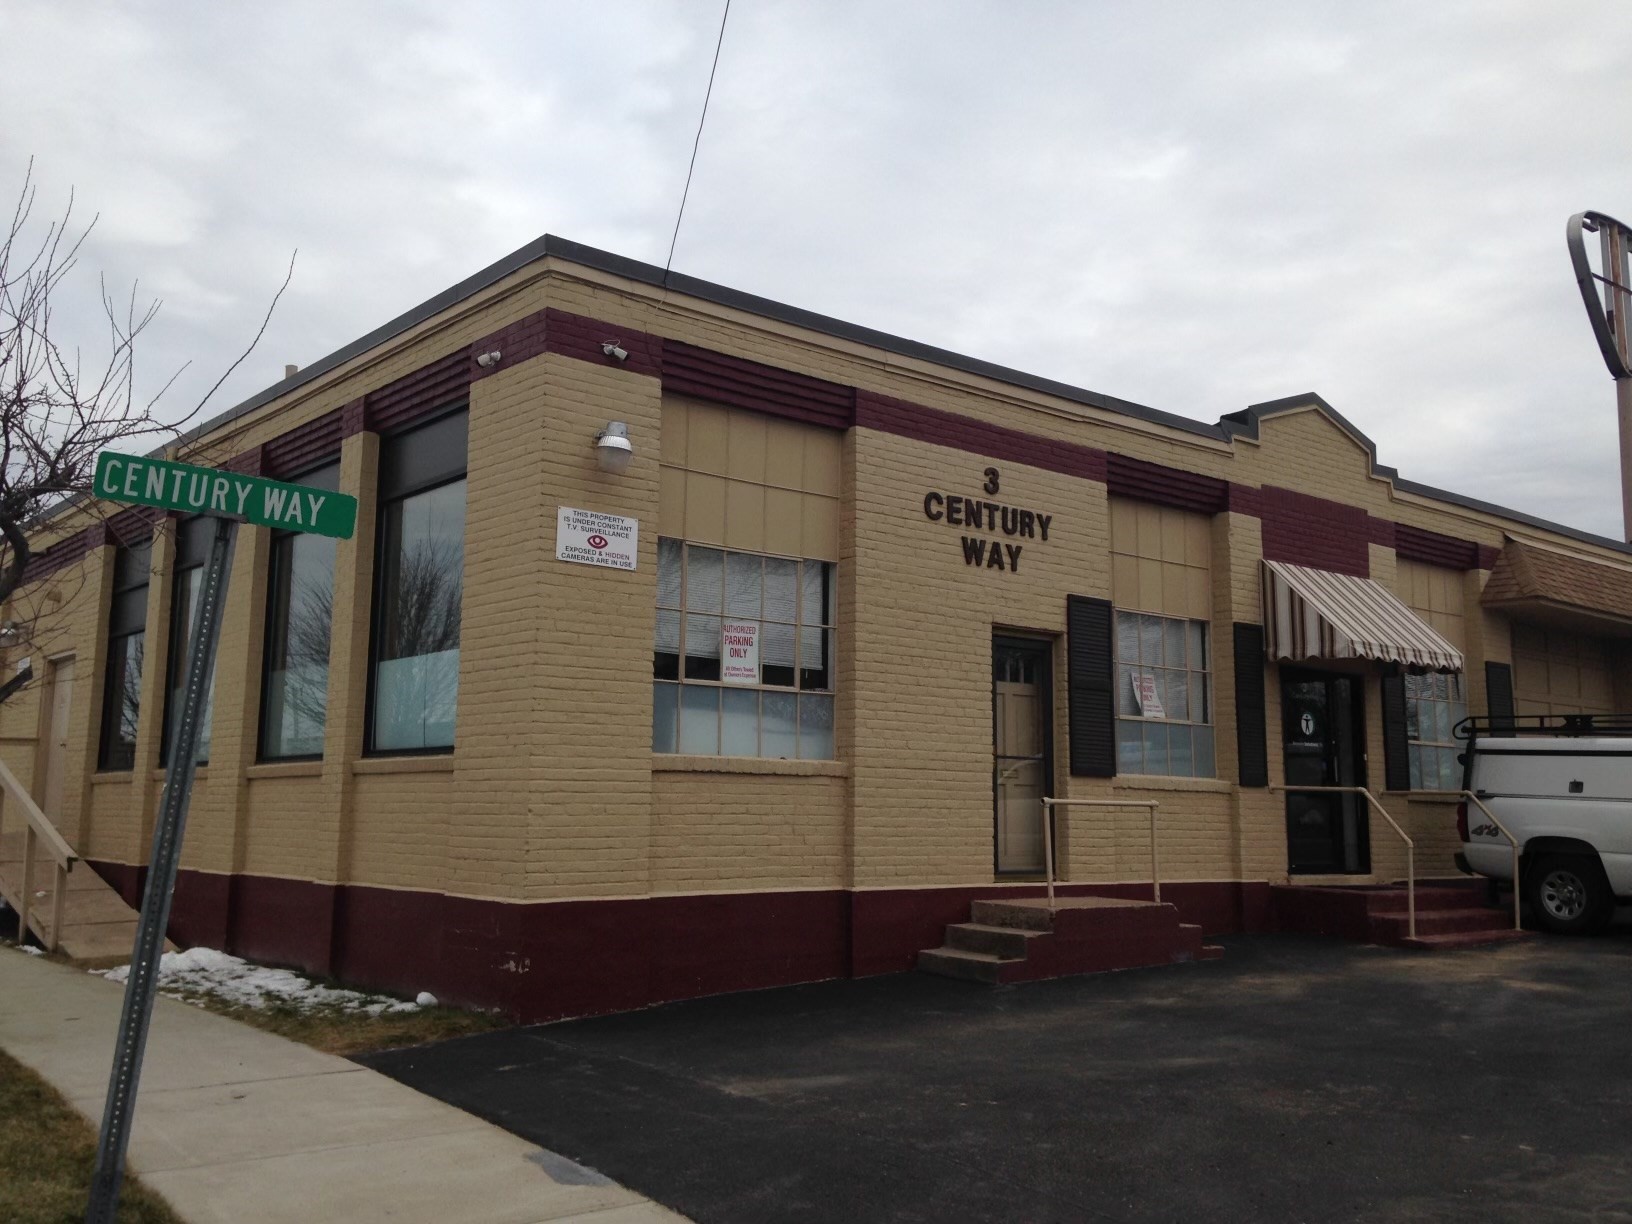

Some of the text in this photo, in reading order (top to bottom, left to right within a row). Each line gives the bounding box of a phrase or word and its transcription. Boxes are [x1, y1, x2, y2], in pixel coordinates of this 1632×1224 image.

[983, 467, 1000, 495] 3
[102, 459, 326, 527] CENTURY WAY
[573, 510, 625, 524] THIS PROPERTY
[924, 491, 1052, 541] CENTURY
[572, 517, 596, 526] UNDER
[597, 521, 633, 532] CONSTANT
[580, 525, 630, 539] SURVEILLANCE
[561, 552, 595, 563] CAMERAS
[596, 557, 610, 565] ARE
[565, 545, 597, 556] EXPOSED
[605, 551, 630, 560] HIDDEN
[961, 535, 1023, 573] WAY
[722, 624, 756, 635] AUTHORIZED
[724, 634, 754, 647] PARKING
[729, 647, 748, 658] ONLY
